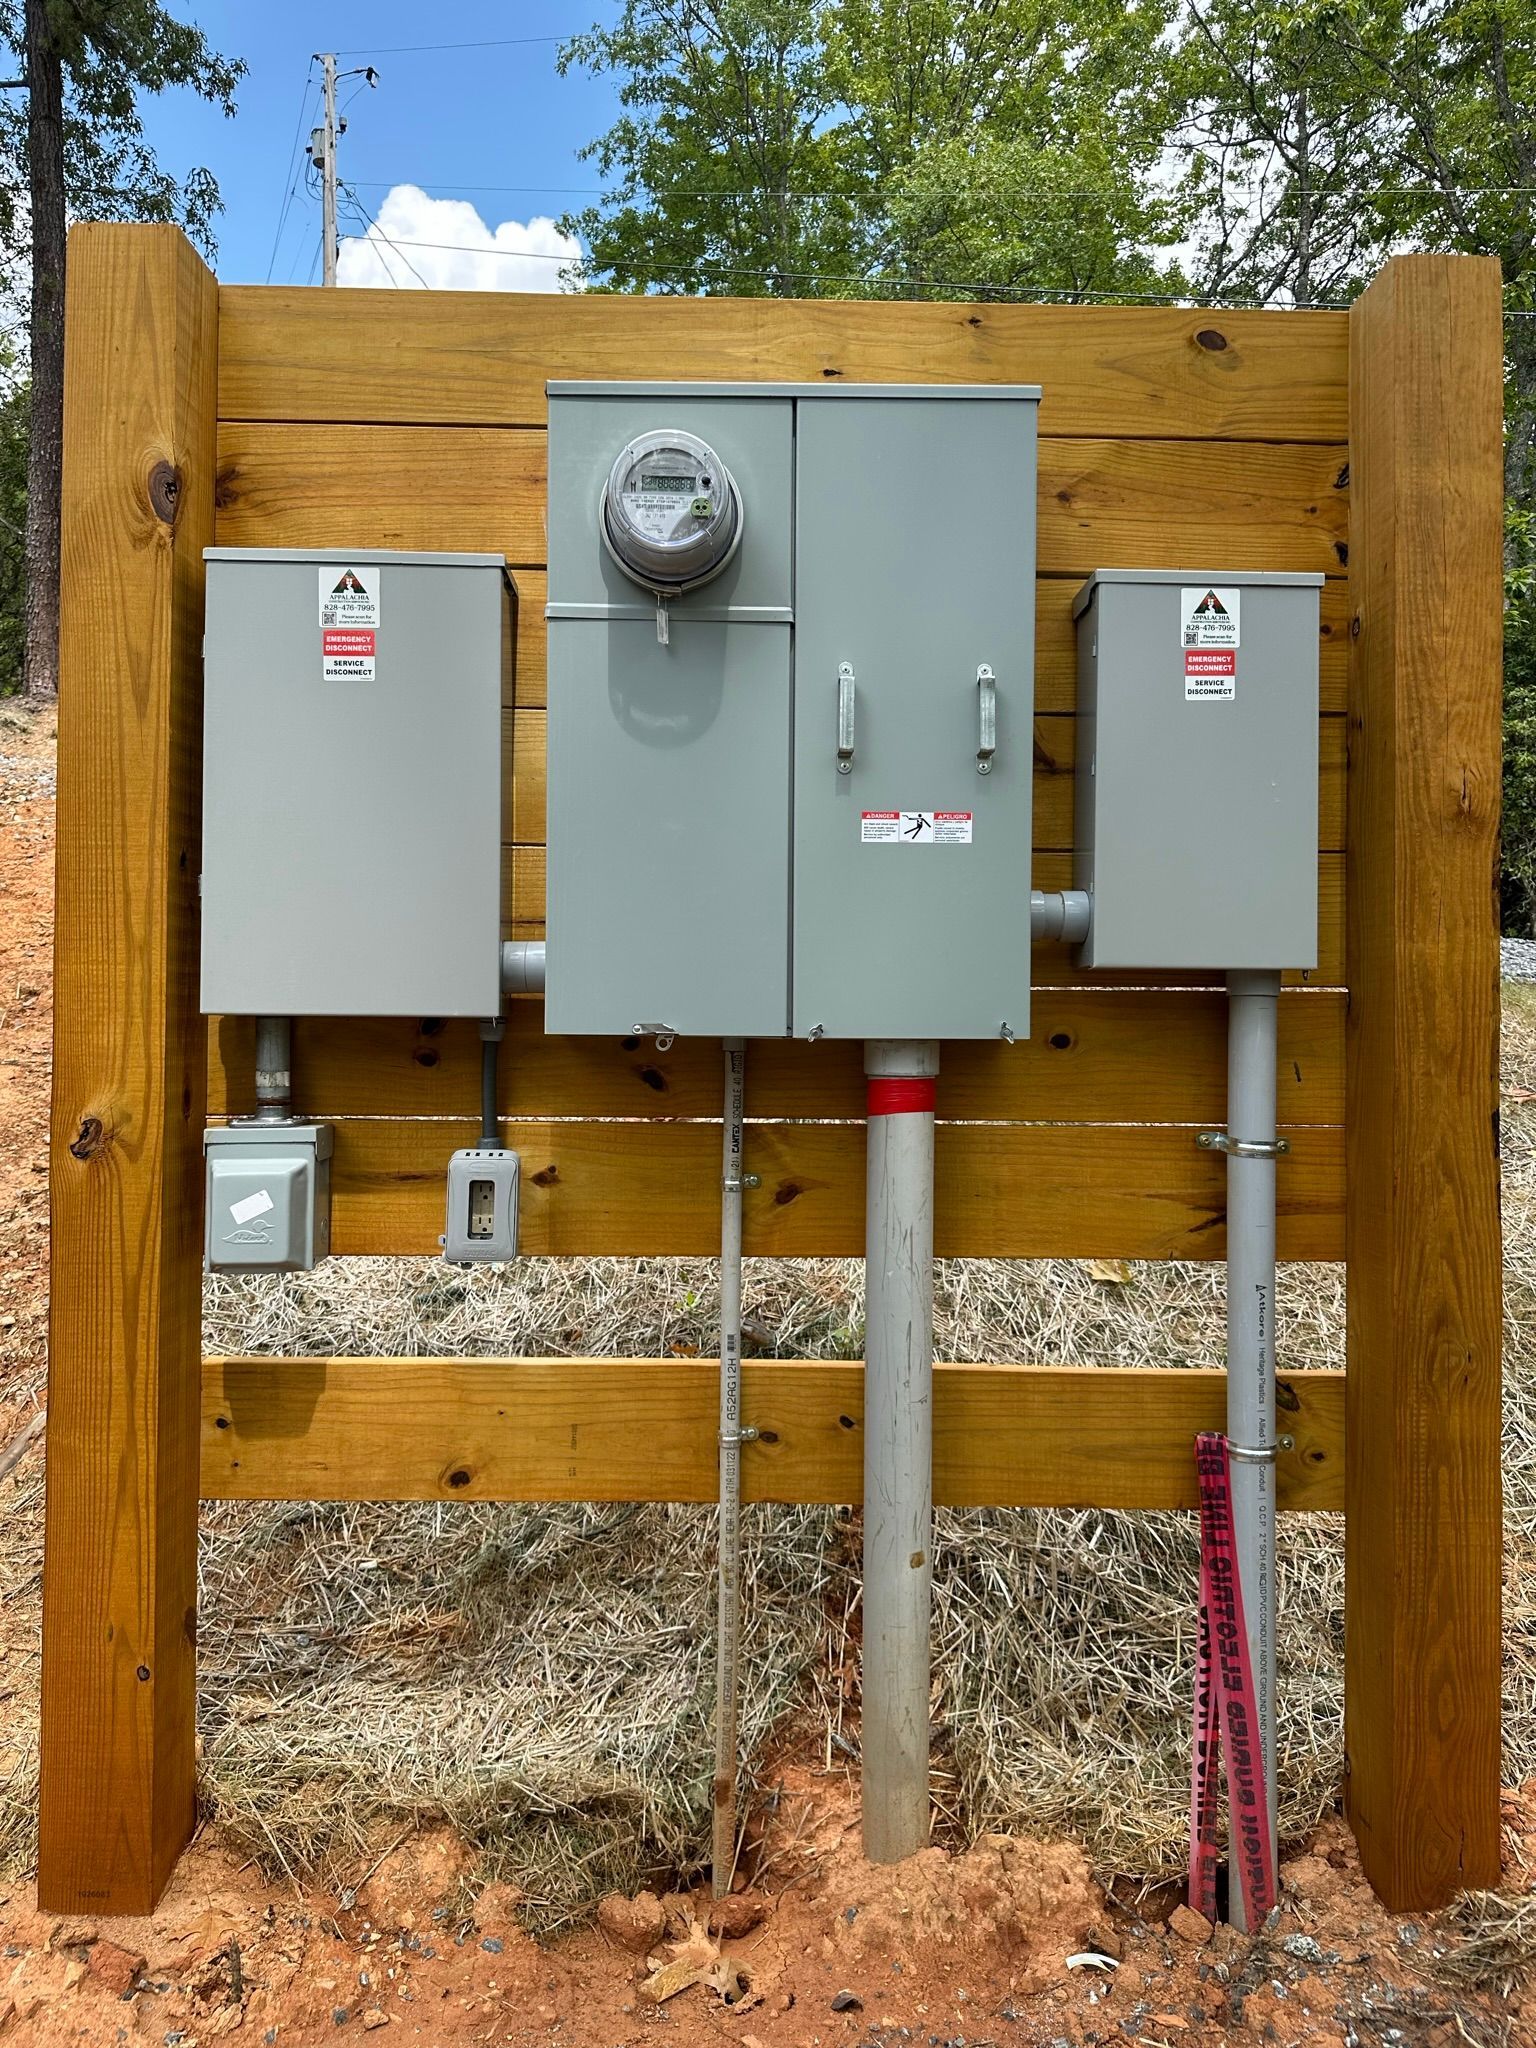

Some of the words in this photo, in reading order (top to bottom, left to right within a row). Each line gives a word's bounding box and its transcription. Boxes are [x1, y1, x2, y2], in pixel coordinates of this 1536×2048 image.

[732, 1089, 742, 1119] SCHEDULE
[732, 1124, 740, 1154] CANTEX
[1257, 1347, 1266, 1376] Heritage
[726, 1357, 737, 1421] A52AG12H
[1258, 1377, 1266, 1404] Plastics
[726, 1451, 736, 1476] 031122
[1259, 1465, 1267, 1492] Conduit
[726, 1499, 736, 1515] TC-2
[725, 1517, 736, 1535] NEMA
[725, 1538, 735, 1554] WIRE
[1259, 1544, 1267, 1560] SCH
[1259, 1562, 1267, 1571] 40
[724, 1592, 734, 1628] RESISTANT
[724, 1631, 734, 1662] SUNLIGHT
[722, 1665, 734, 1708] UNDERGROUND
